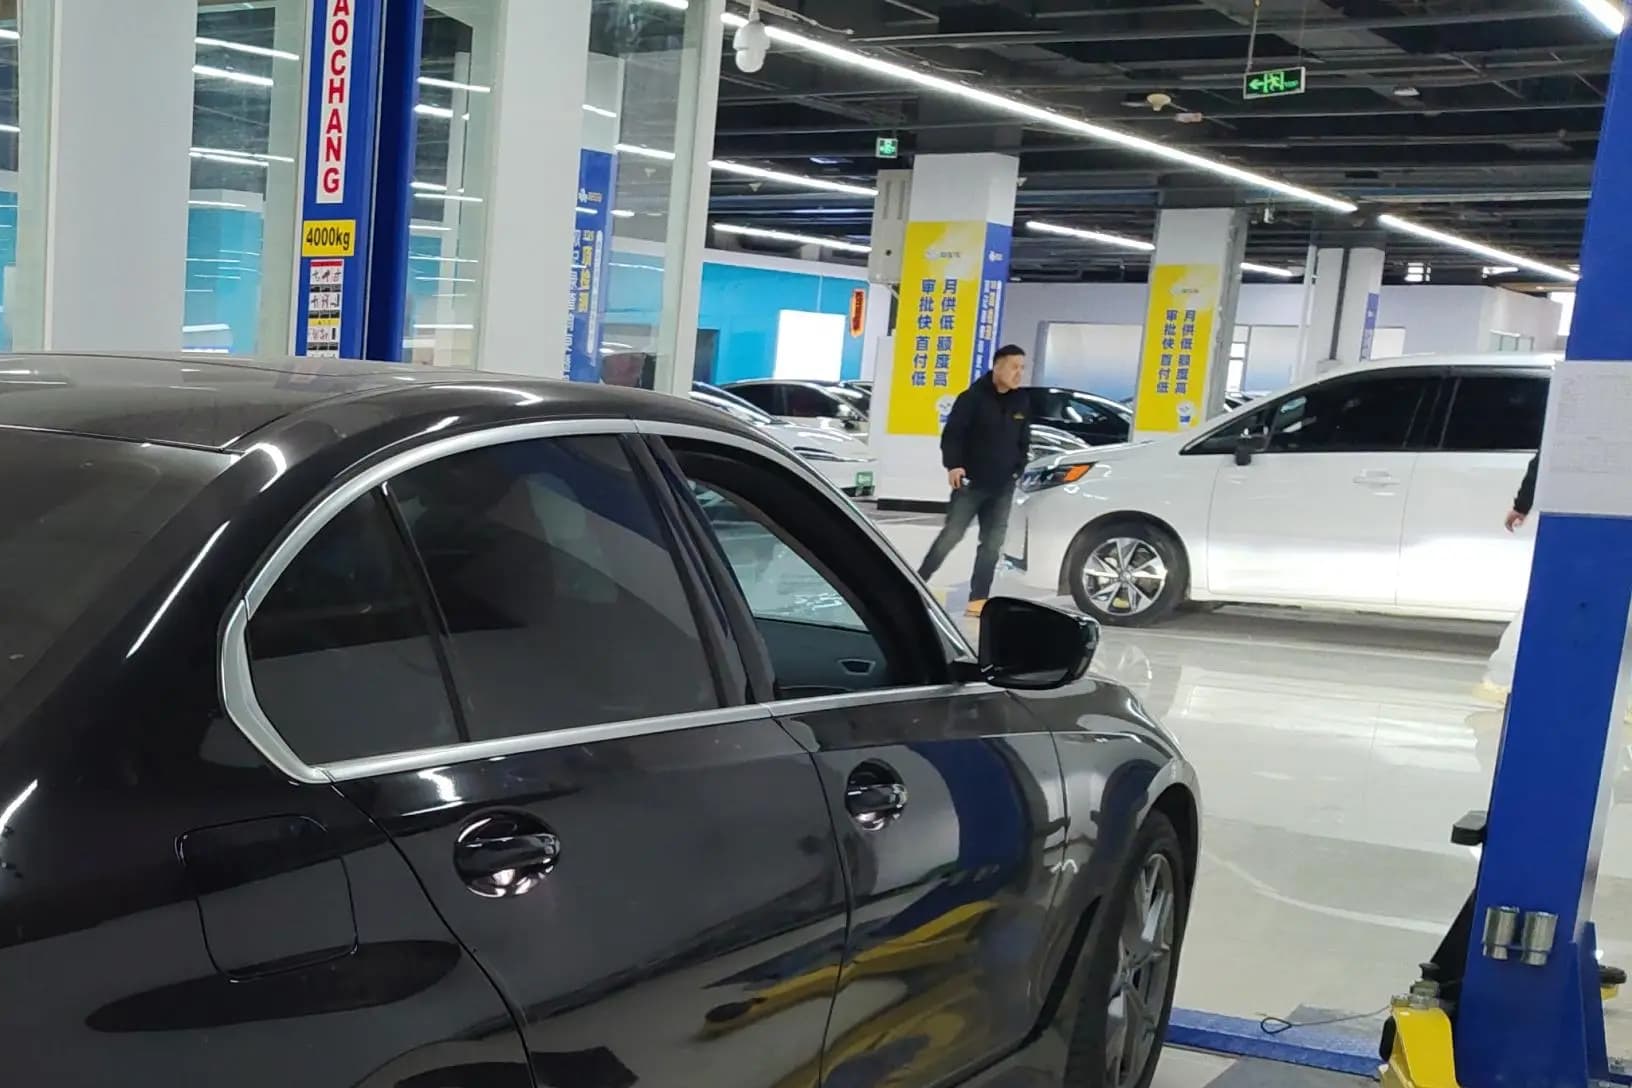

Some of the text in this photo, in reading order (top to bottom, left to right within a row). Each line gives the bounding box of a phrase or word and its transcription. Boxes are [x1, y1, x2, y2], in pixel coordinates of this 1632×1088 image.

[323, 0, 350, 193] AOCHANG
[306, 227, 350, 251] 4000kg
[940, 279, 958, 330] 月供低
